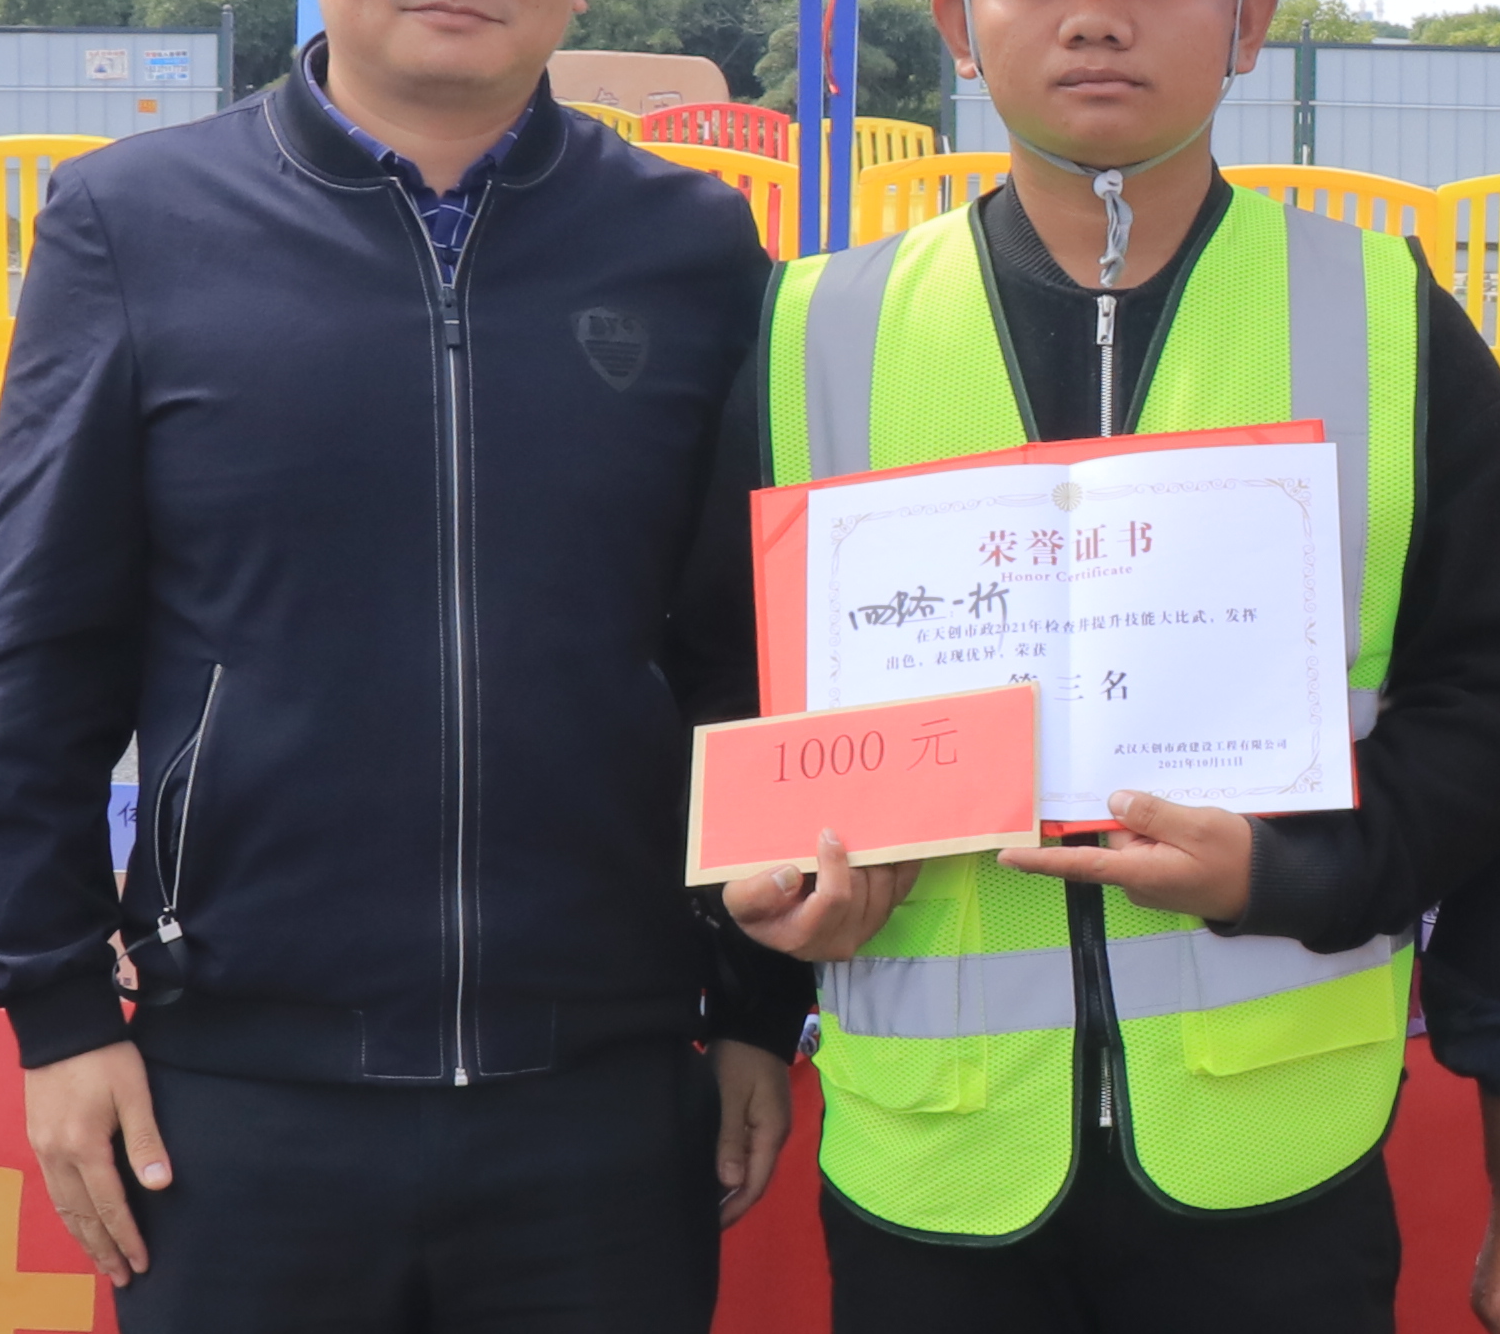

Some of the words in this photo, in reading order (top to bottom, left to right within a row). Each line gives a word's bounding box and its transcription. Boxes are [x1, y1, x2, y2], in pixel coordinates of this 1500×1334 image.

[978, 521, 1153, 567] 荣誉证书
[1001, 571, 1050, 583] Honor
[1056, 565, 1132, 583] Certificate
[773, 730, 885, 783] 1000
[906, 718, 959, 772] 元
[1113, 738, 1288, 755] 武汉天创市政建设工程有限公司
